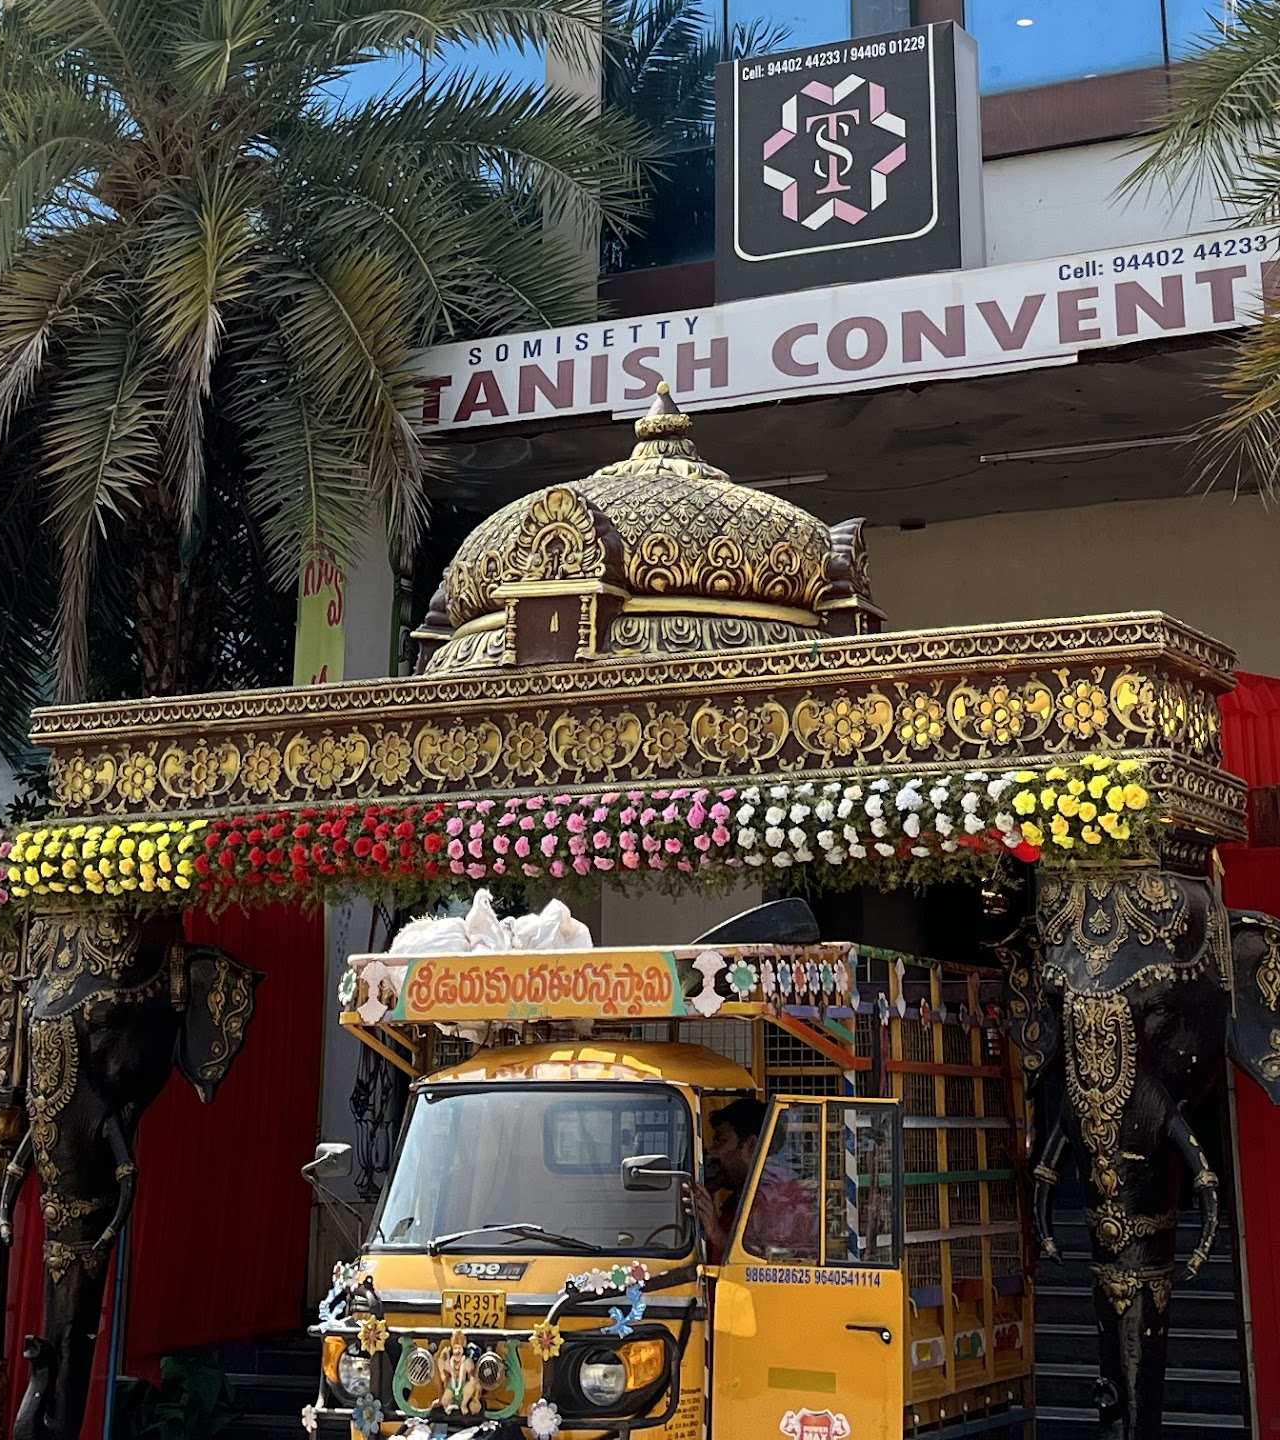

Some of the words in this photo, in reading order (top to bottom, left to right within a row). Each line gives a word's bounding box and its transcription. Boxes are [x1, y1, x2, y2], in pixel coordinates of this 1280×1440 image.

[742, 67, 765, 81] Cell:
[767, 57, 803, 76] 94402
[805, 50, 840, 68] 44233
[850, 41, 886, 61] 94406
[889, 35, 926, 54] 01229
[1058, 261, 1104, 282] Cell:
[1112, 247, 1185, 275] 94402
[1192, 234, 1268, 262] 44233
[468, 316, 699, 365] SOMISETTY
[418, 336, 730, 426] TANISH
[453, 1262, 501, 1277] ape
[745, 1267, 812, 1284] 9866828625
[814, 1269, 882, 1288] 9640541114
[454, 1294, 499, 1311] AP39T
[453, 1311, 500, 1329] S5242
